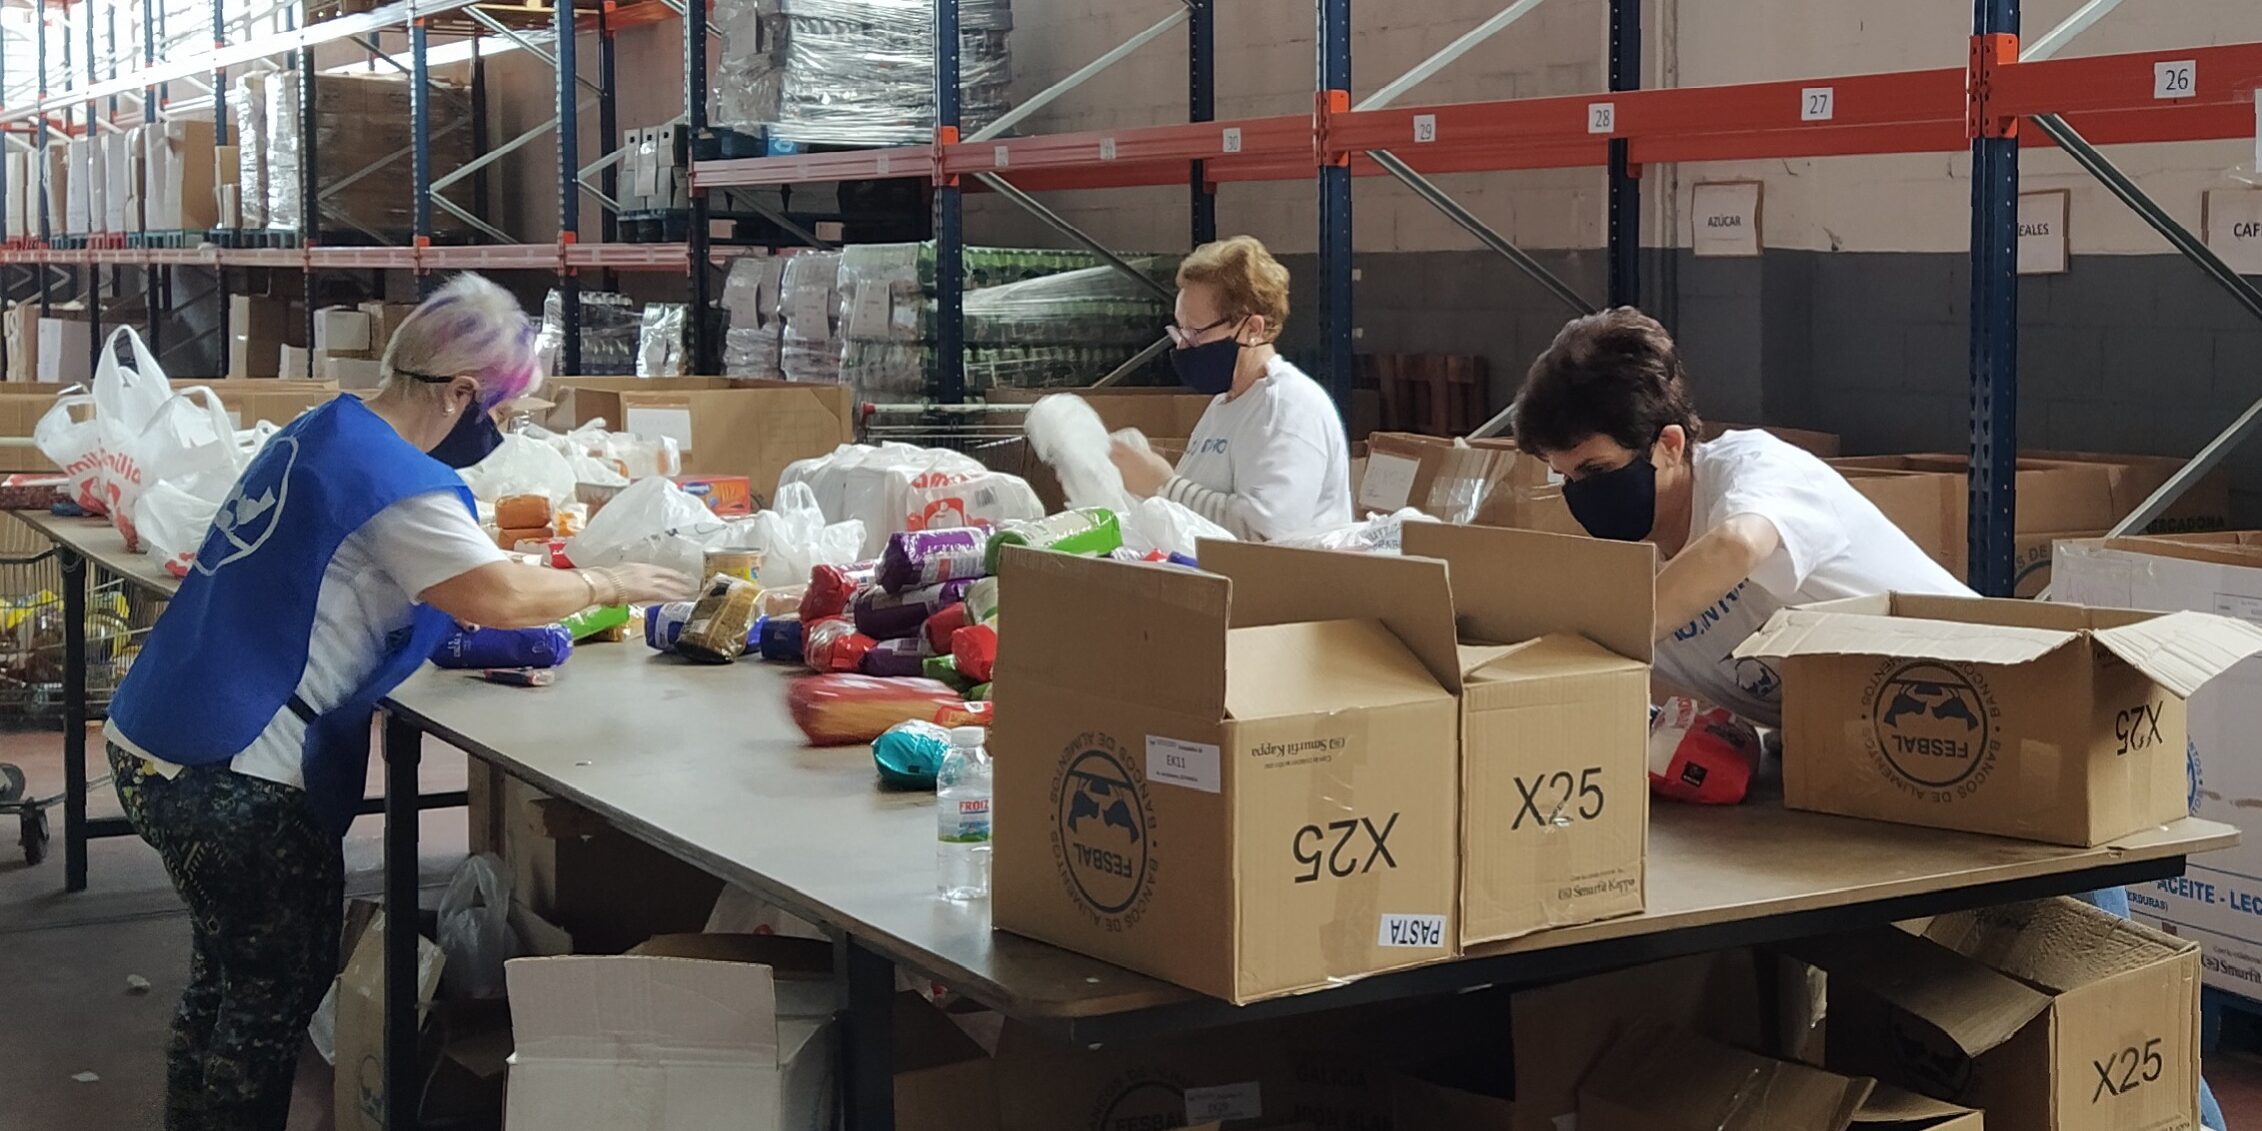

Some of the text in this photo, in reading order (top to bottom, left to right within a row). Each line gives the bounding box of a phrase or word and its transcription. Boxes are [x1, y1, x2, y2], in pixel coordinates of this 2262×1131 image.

[2165, 68, 2189, 90] 26
[1809, 94, 1828, 114] 27
[1595, 109, 1610, 127] 28
[1420, 123, 1432, 140] 29
[1707, 213, 1742, 227] AZÚCAR
[2115, 700, 2164, 756] X25
[1251, 738, 1328, 757] Smurfit Kappa
[1891, 734, 1968, 759] FESBAL
[1051, 732, 1158, 831] BANCOS DE ALIMENTOS
[1957, 739, 2001, 799] BANCOS
[959, 800, 989, 812] FROIZ
[1511, 766, 1604, 830] X25
[1931, 790, 1953, 804] DE
[1073, 842, 1133, 878] FESBAL
[1292, 812, 1400, 884] X25
[1051, 831, 1159, 933] BANCOS DE ALIMENTOS
[2157, 876, 2215, 904] ACEITE
[1390, 919, 1442, 945] PASTA
[2092, 1037, 2163, 1105] X25
